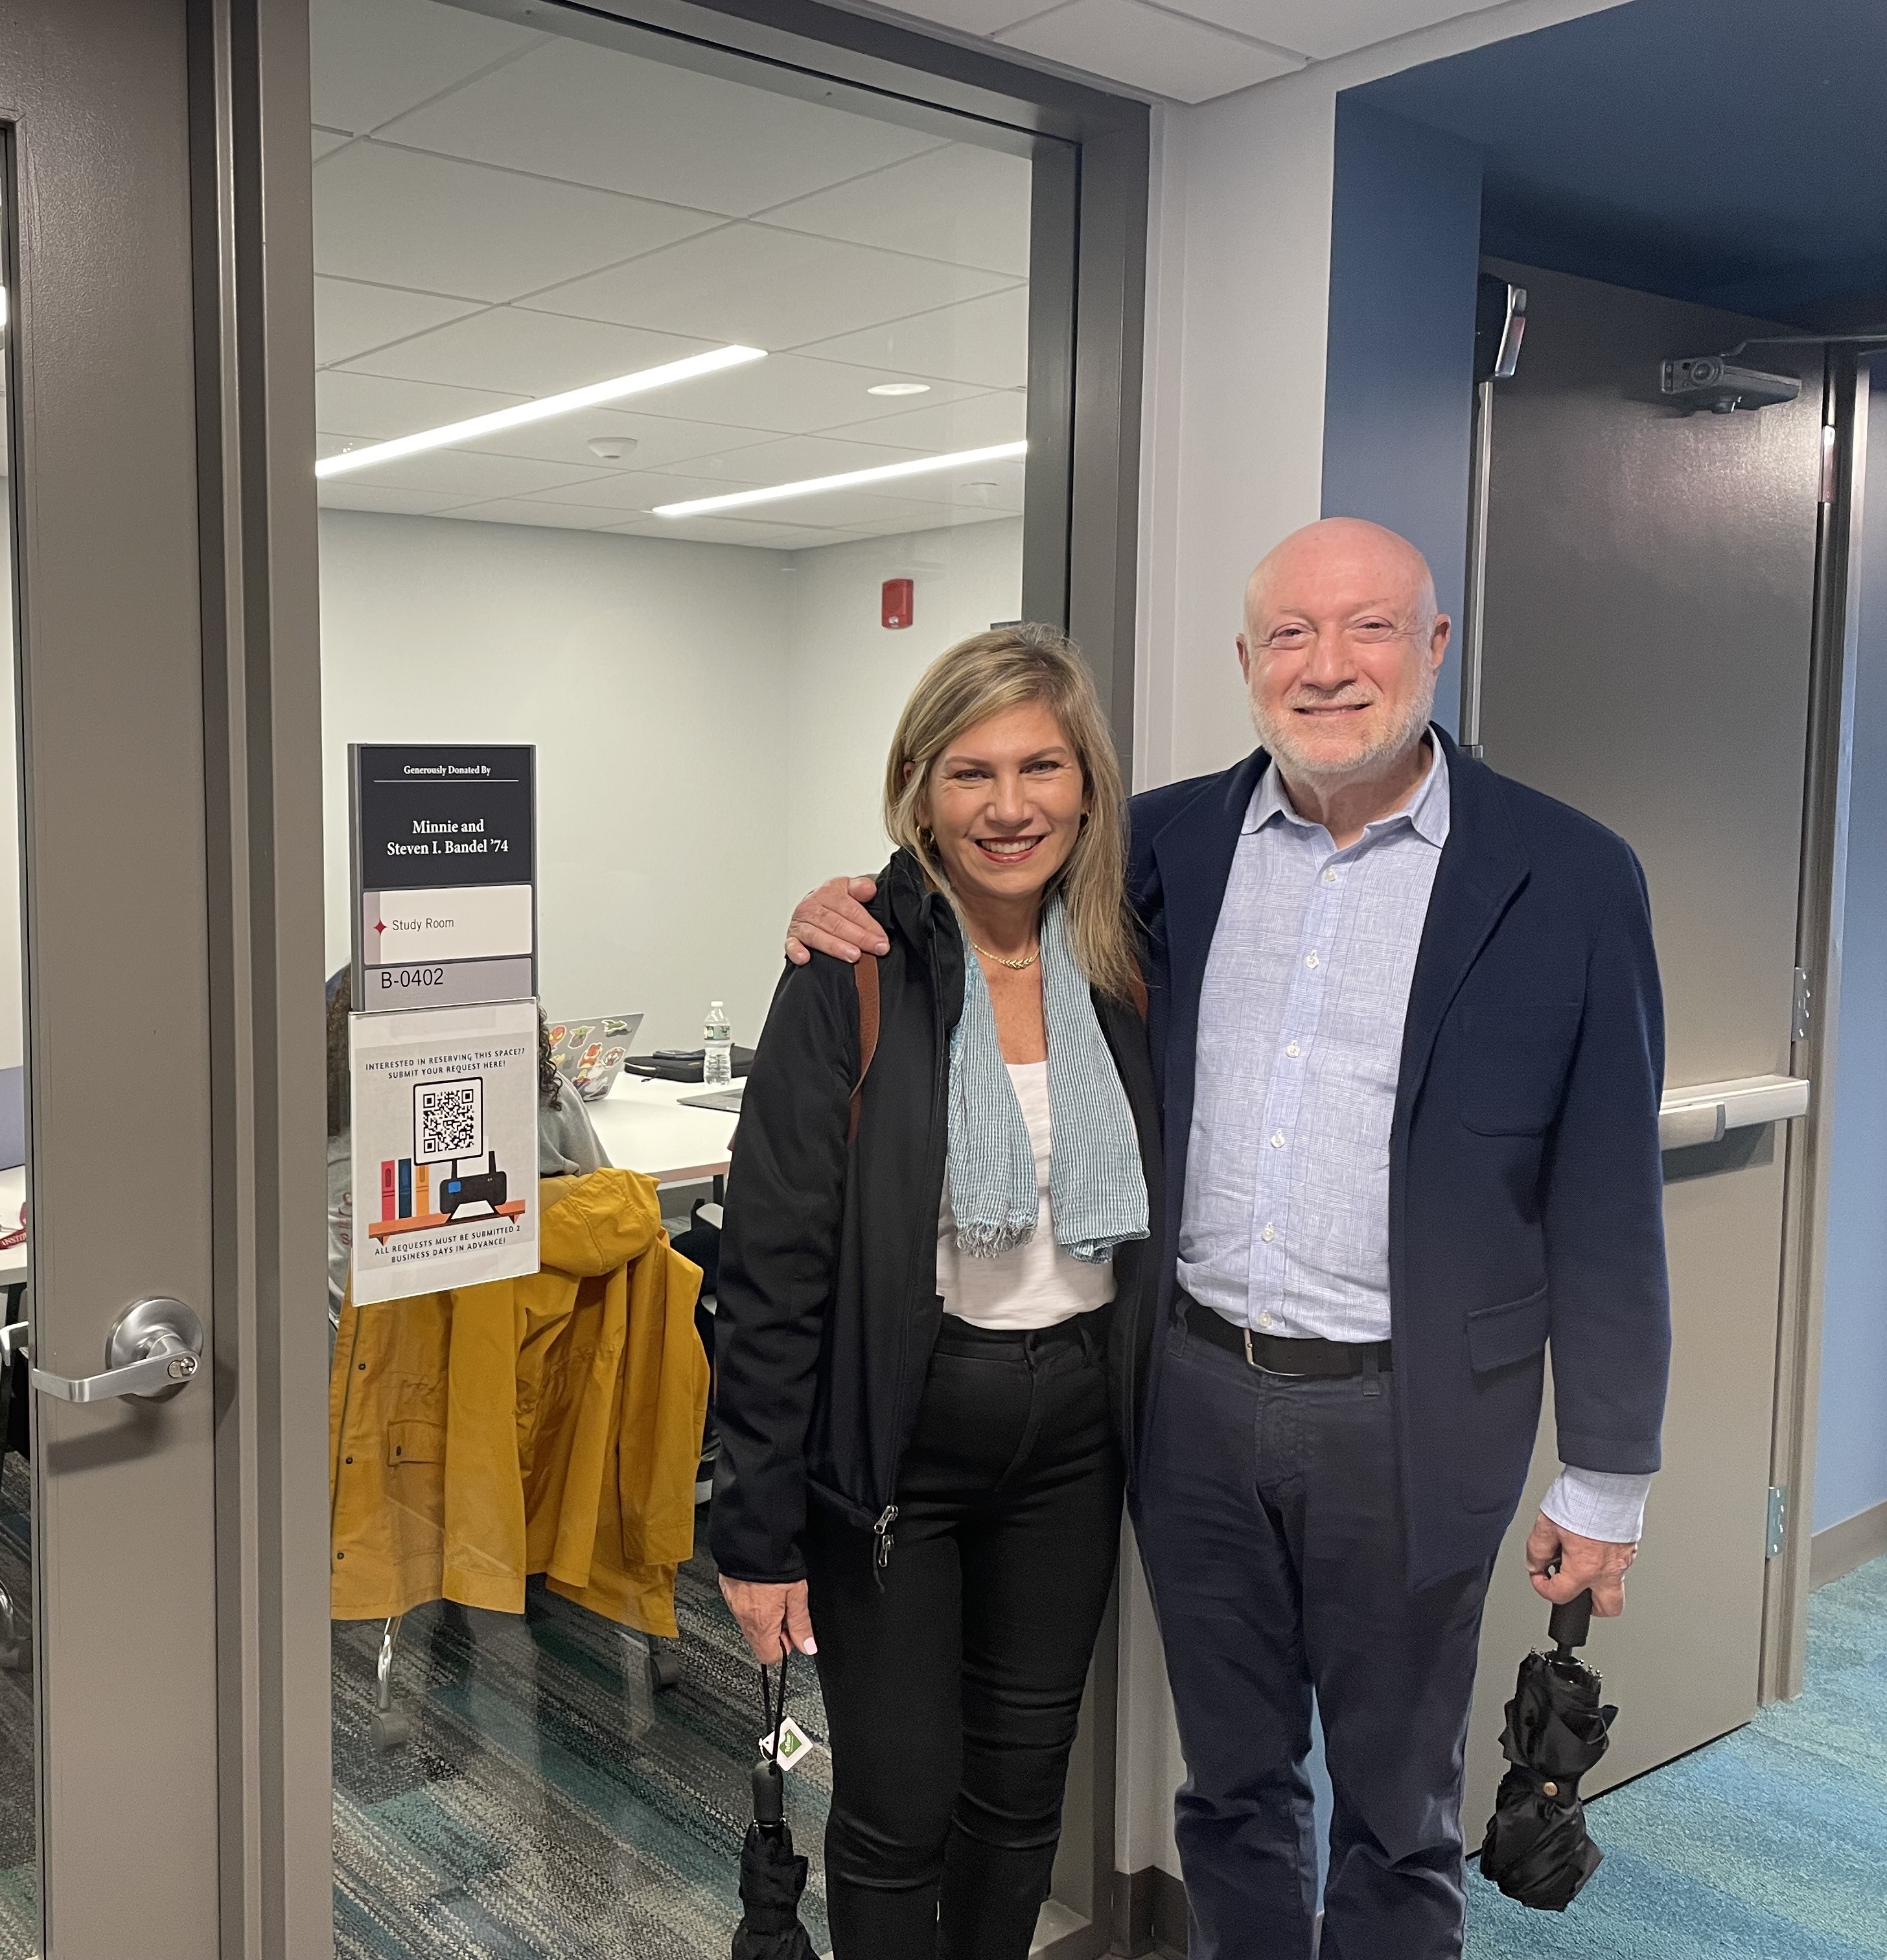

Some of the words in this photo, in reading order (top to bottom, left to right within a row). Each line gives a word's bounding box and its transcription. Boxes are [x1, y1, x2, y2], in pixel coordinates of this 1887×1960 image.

[403, 765, 447, 776] Generously
[448, 765, 480, 775] Donated
[481, 765, 491, 776] By
[412, 819, 458, 834] Minnie
[461, 819, 485, 833] and
[387, 841, 430, 856] Steven
[432, 841, 441, 854] I.
[445, 839, 488, 854] Bandel
[392, 918, 422, 932] Study
[426, 918, 454, 929] Room
[381, 968, 444, 989] B-0402
[365, 1059, 415, 1071] INTERESTED
[429, 1053, 472, 1064] RESERVING
[474, 1051, 492, 1059] THIS
[494, 1047, 525, 1057] SPACE??
[388, 1069, 419, 1079] SUBMIT
[421, 1066, 443, 1075] YOUR
[446, 1062, 481, 1073] REQUEST
[483, 1060, 505, 1069] HERE!
[375, 1246, 389, 1255] ALL
[391, 1239, 432, 1253] REQUESTS
[435, 1235, 457, 1245] MUST
[472, 1226, 514, 1239] SUBMITTED
[391, 1250, 430, 1263] BUSINESS
[432, 1246, 453, 1256] DAYS
[467, 1237, 505, 1250] ADVANCE!
